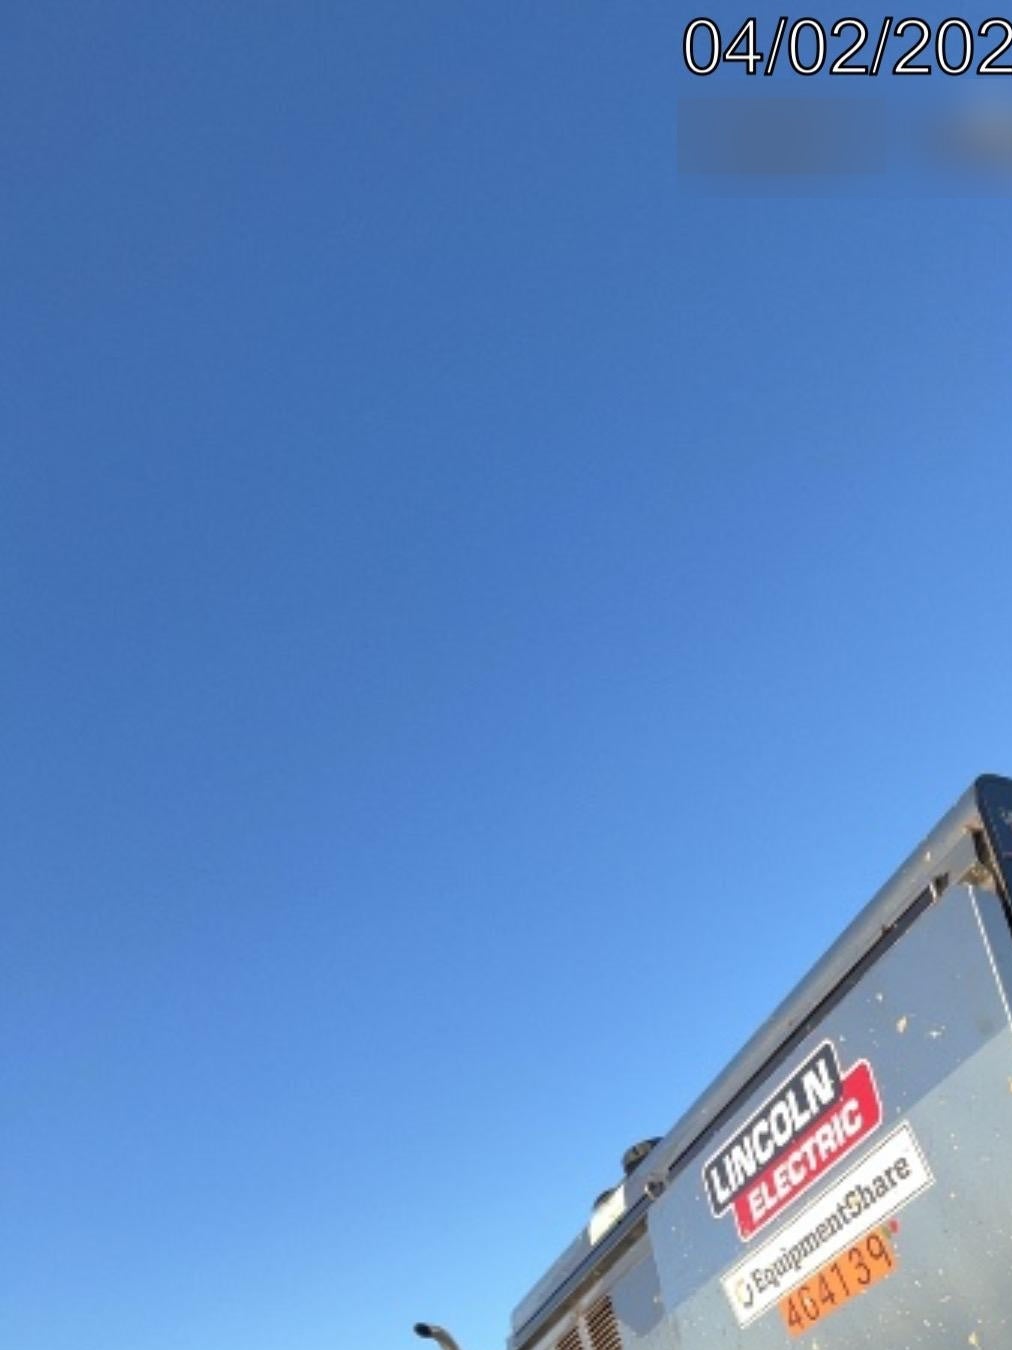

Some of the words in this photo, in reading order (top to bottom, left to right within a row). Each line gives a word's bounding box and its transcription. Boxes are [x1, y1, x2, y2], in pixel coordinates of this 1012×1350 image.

[709, 1058, 836, 1203] LINCOLN
[746, 1097, 864, 1224] ELECTRIC
[750, 1156, 912, 1294] EquipmentShare
